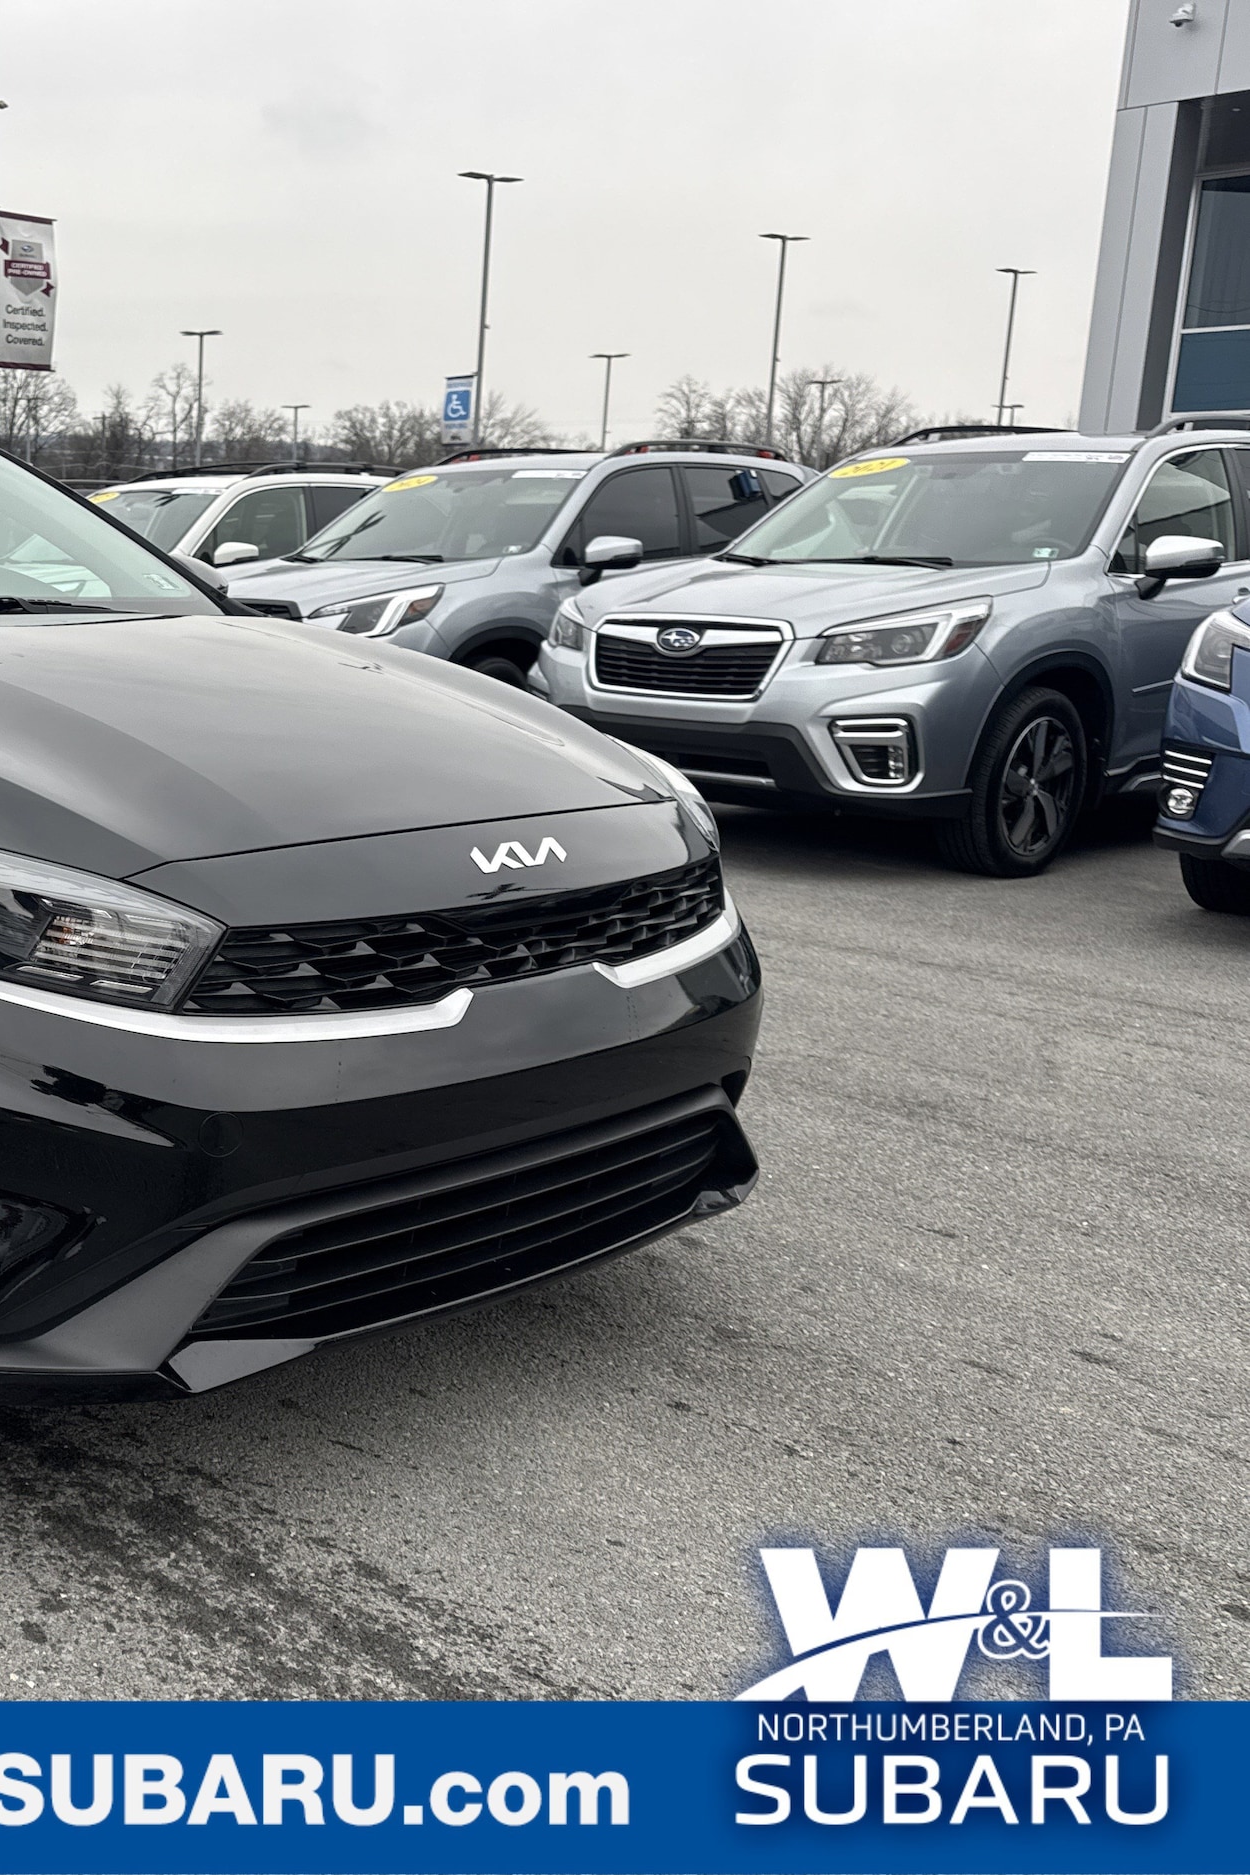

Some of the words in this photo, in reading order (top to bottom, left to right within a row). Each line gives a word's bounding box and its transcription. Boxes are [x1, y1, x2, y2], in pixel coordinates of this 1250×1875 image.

[5, 304, 46, 317] Certified.
[3, 319, 48, 332] Inspected.
[5, 334, 45, 346] Covered.
[470, 837, 567, 873] KIA
